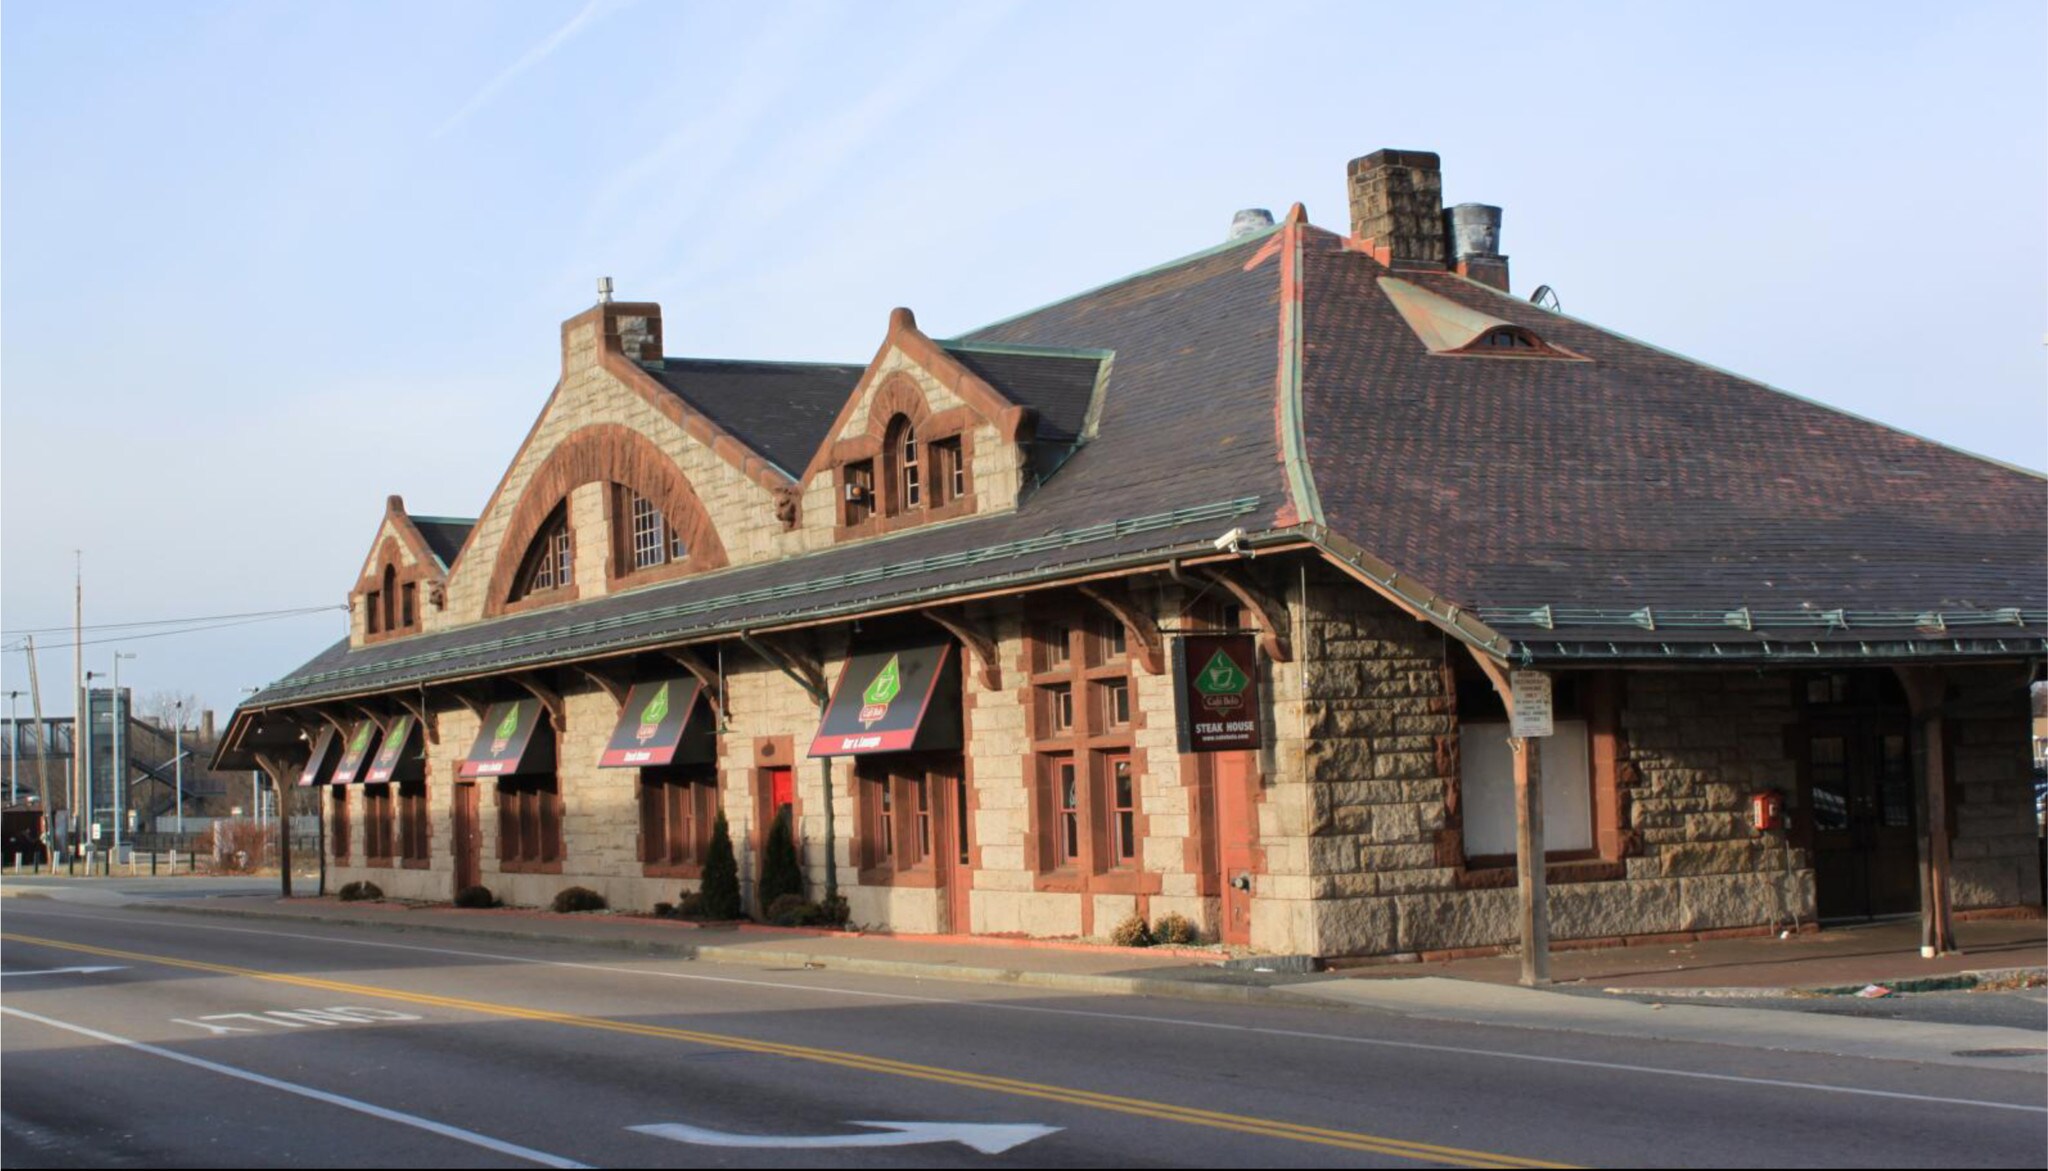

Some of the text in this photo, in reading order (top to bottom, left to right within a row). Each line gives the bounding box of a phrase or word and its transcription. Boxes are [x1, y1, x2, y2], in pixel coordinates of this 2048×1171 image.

[1195, 721, 1254, 734] STEAK HOUSE
[169, 1006, 424, 1035] ONLY
